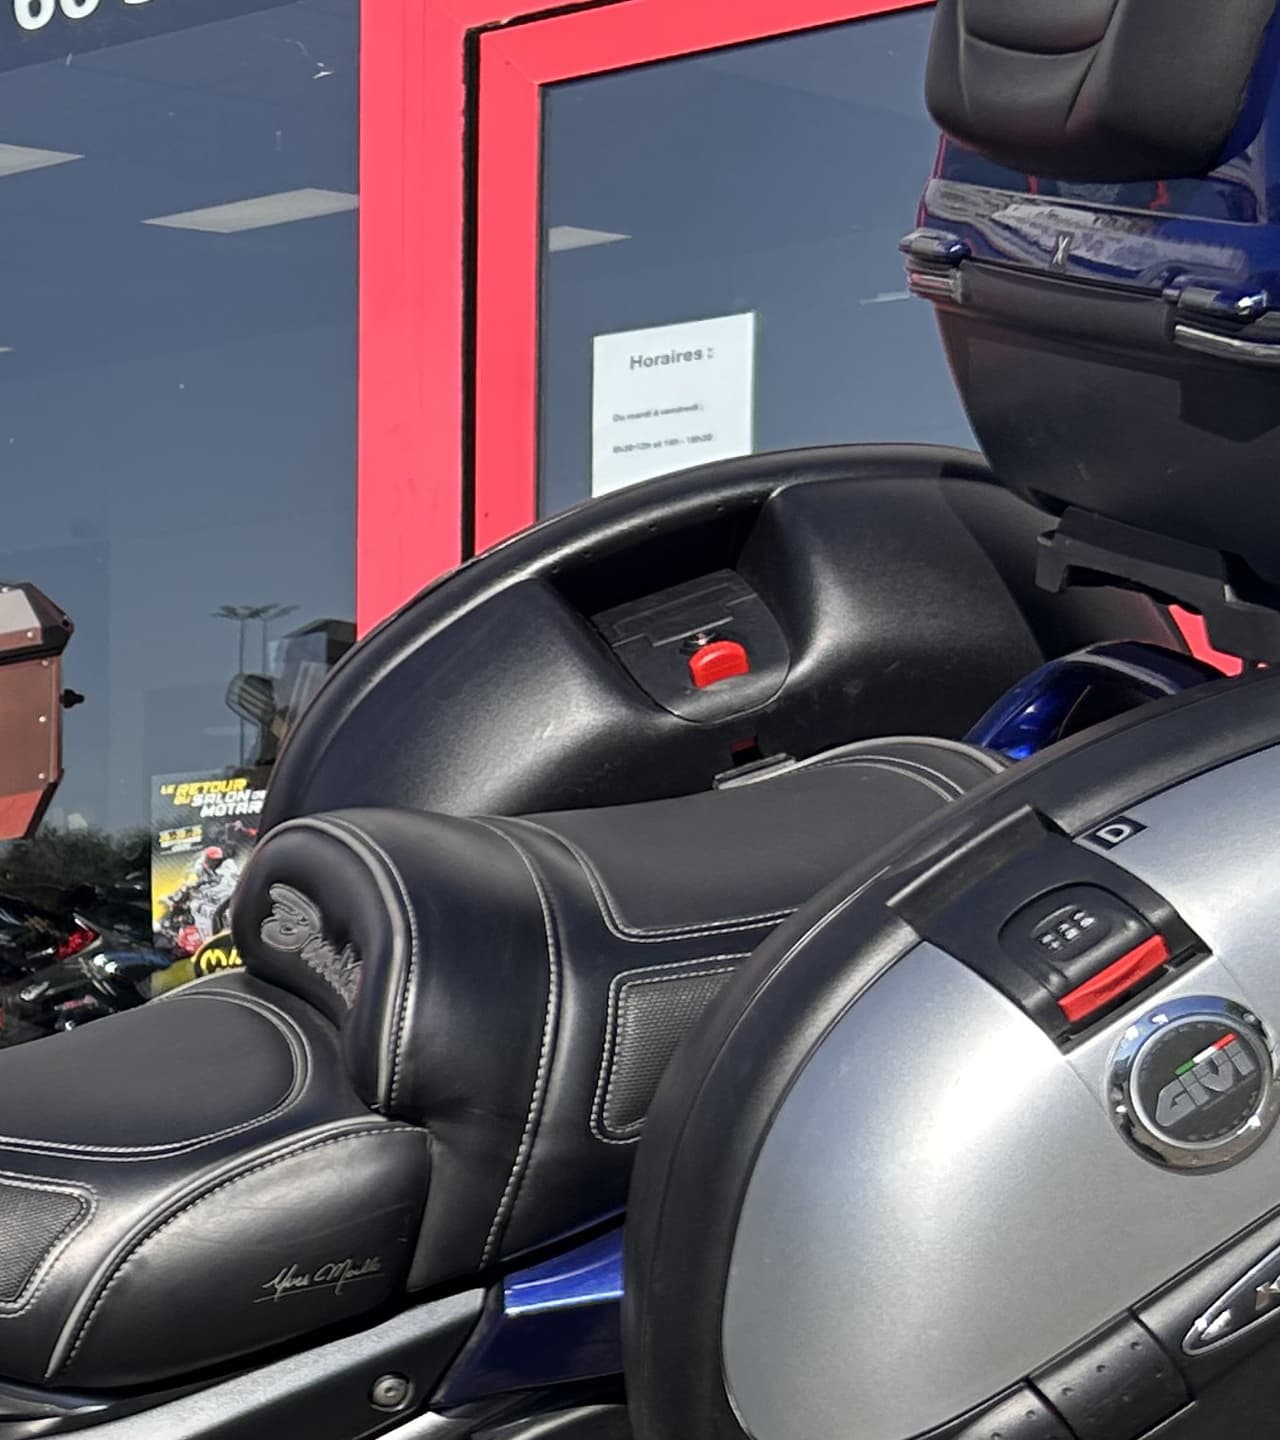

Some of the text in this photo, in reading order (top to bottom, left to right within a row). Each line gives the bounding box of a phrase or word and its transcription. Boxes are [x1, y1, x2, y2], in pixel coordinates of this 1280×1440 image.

[629, 348, 703, 371] Horaires
[176, 777, 248, 795] RETOUR
[191, 789, 251, 807] SALON
[1155, 1042, 1256, 1128] GIVI
